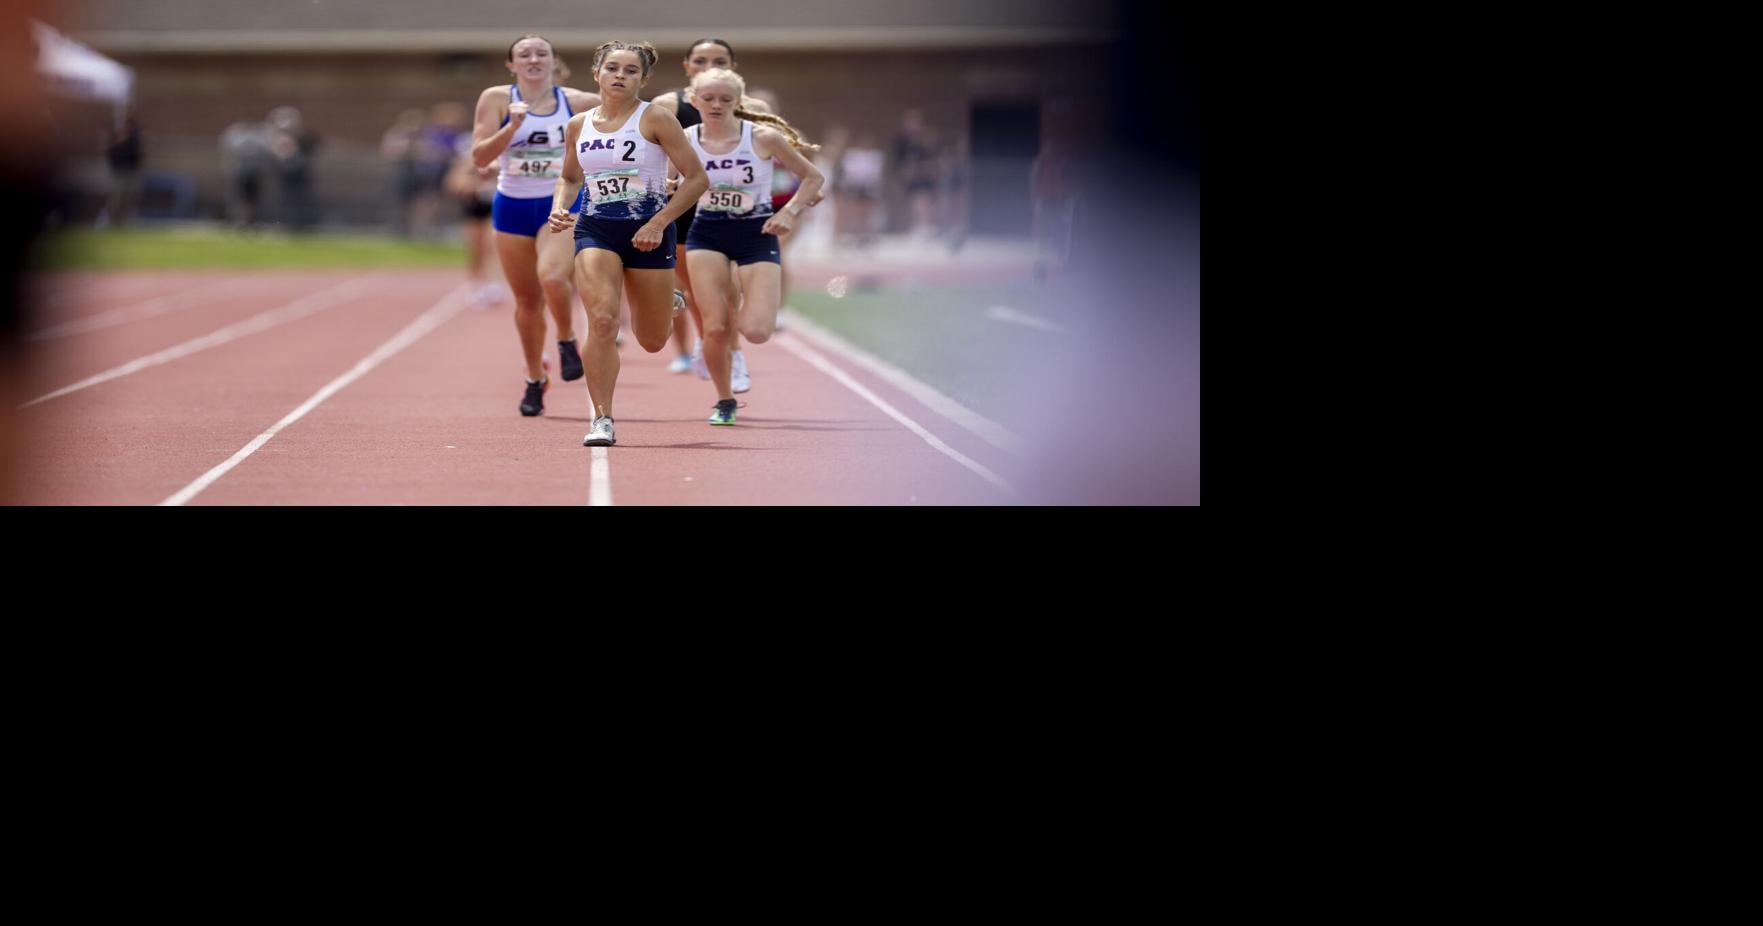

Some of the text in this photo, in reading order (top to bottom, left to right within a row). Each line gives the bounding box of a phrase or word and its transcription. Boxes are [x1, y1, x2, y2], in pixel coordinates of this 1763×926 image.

[622, 140, 636, 162] 2
[520, 160, 552, 173] 497
[743, 166, 754, 184] 3
[597, 177, 629, 196] 537
[710, 192, 742, 208] 550
